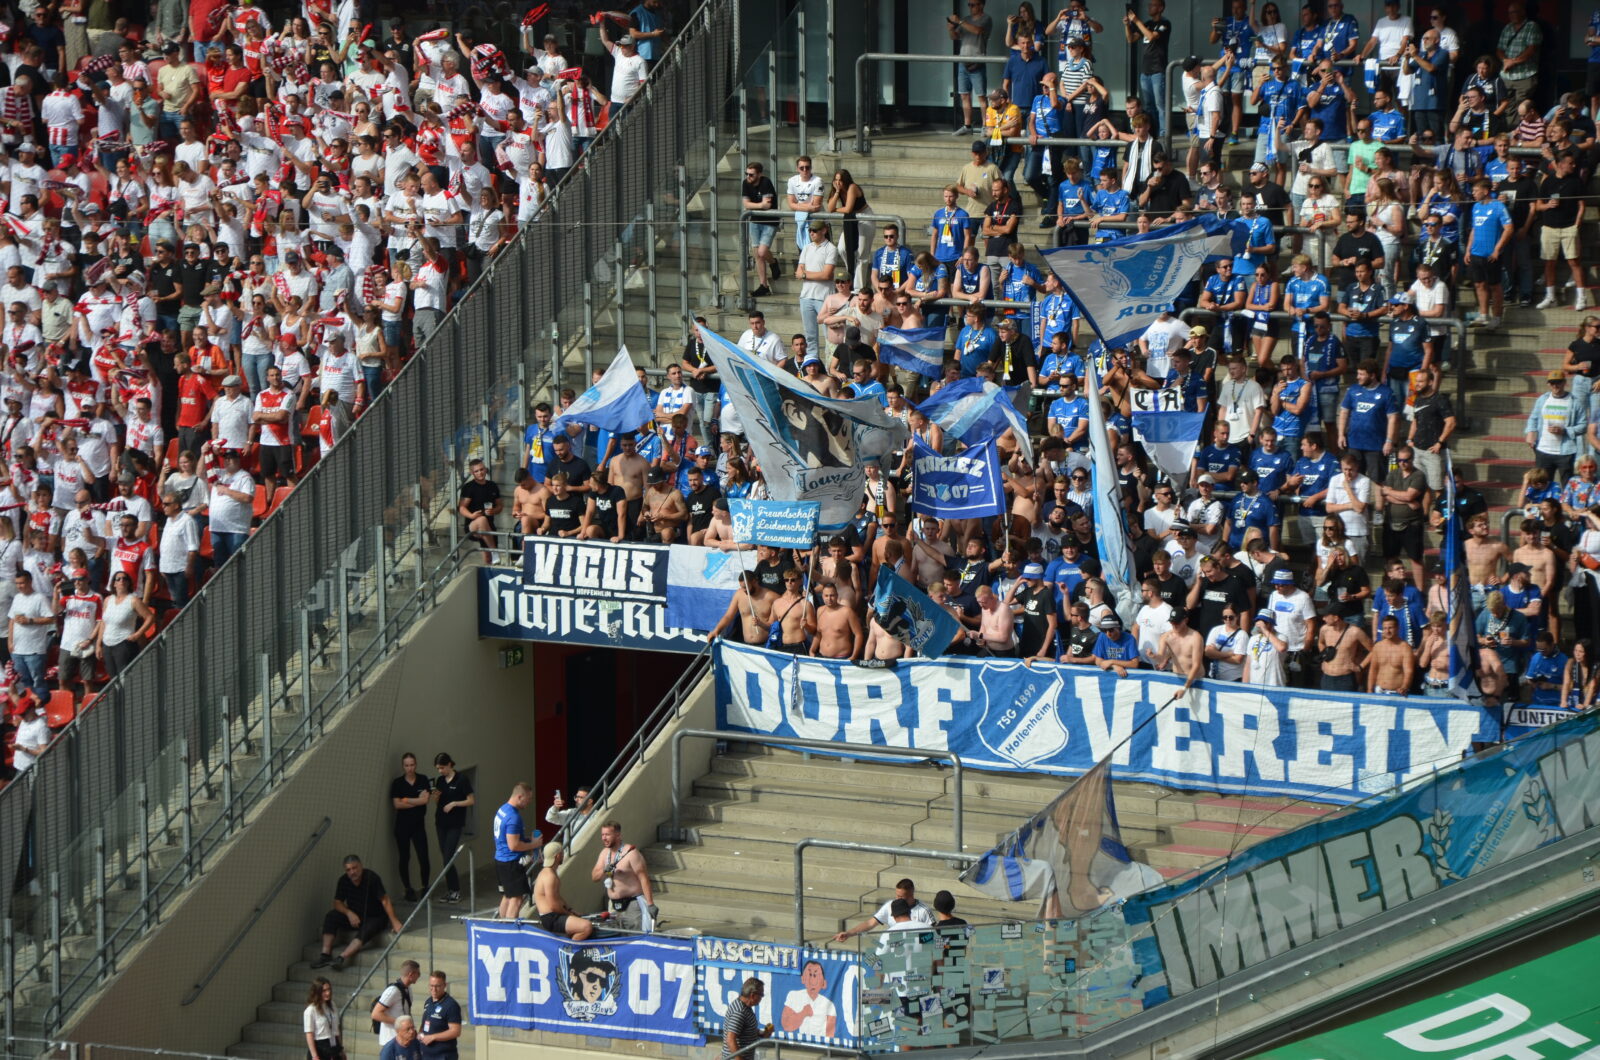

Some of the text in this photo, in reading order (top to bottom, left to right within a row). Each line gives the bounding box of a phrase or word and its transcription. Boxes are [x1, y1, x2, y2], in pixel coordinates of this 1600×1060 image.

[534, 543, 657, 594] VICUS
[719, 645, 1481, 795] DORF VEREIN
[997, 684, 1036, 730] TSG 1899
[1149, 815, 1441, 998] IMMER
[477, 944, 552, 1005] YB
[627, 958, 693, 1020] 07
[697, 940, 799, 969] NASCENTI
